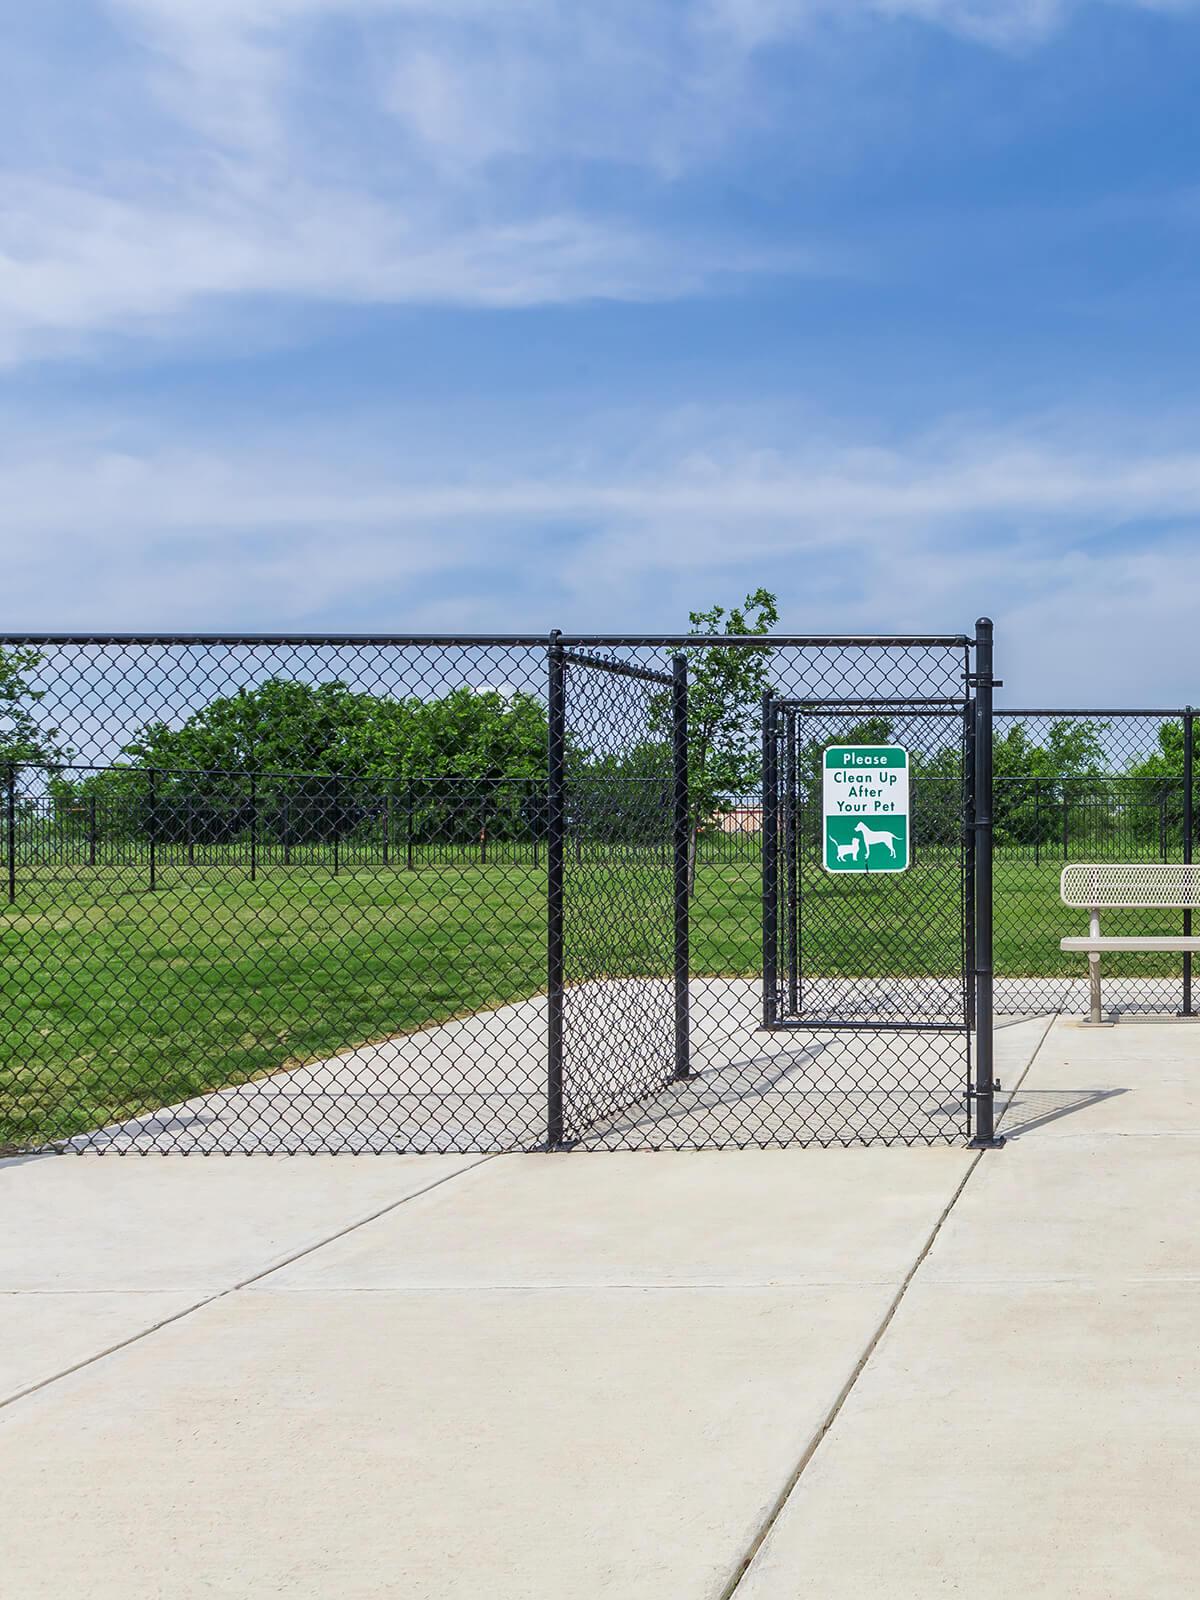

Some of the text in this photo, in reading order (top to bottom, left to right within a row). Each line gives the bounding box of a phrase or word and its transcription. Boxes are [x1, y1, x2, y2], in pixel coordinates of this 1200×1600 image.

[843, 752, 888, 765] Please
[834, 771, 897, 786] Clean Up
[848, 785, 883, 797] After
[837, 801, 895, 812] Your Pet
